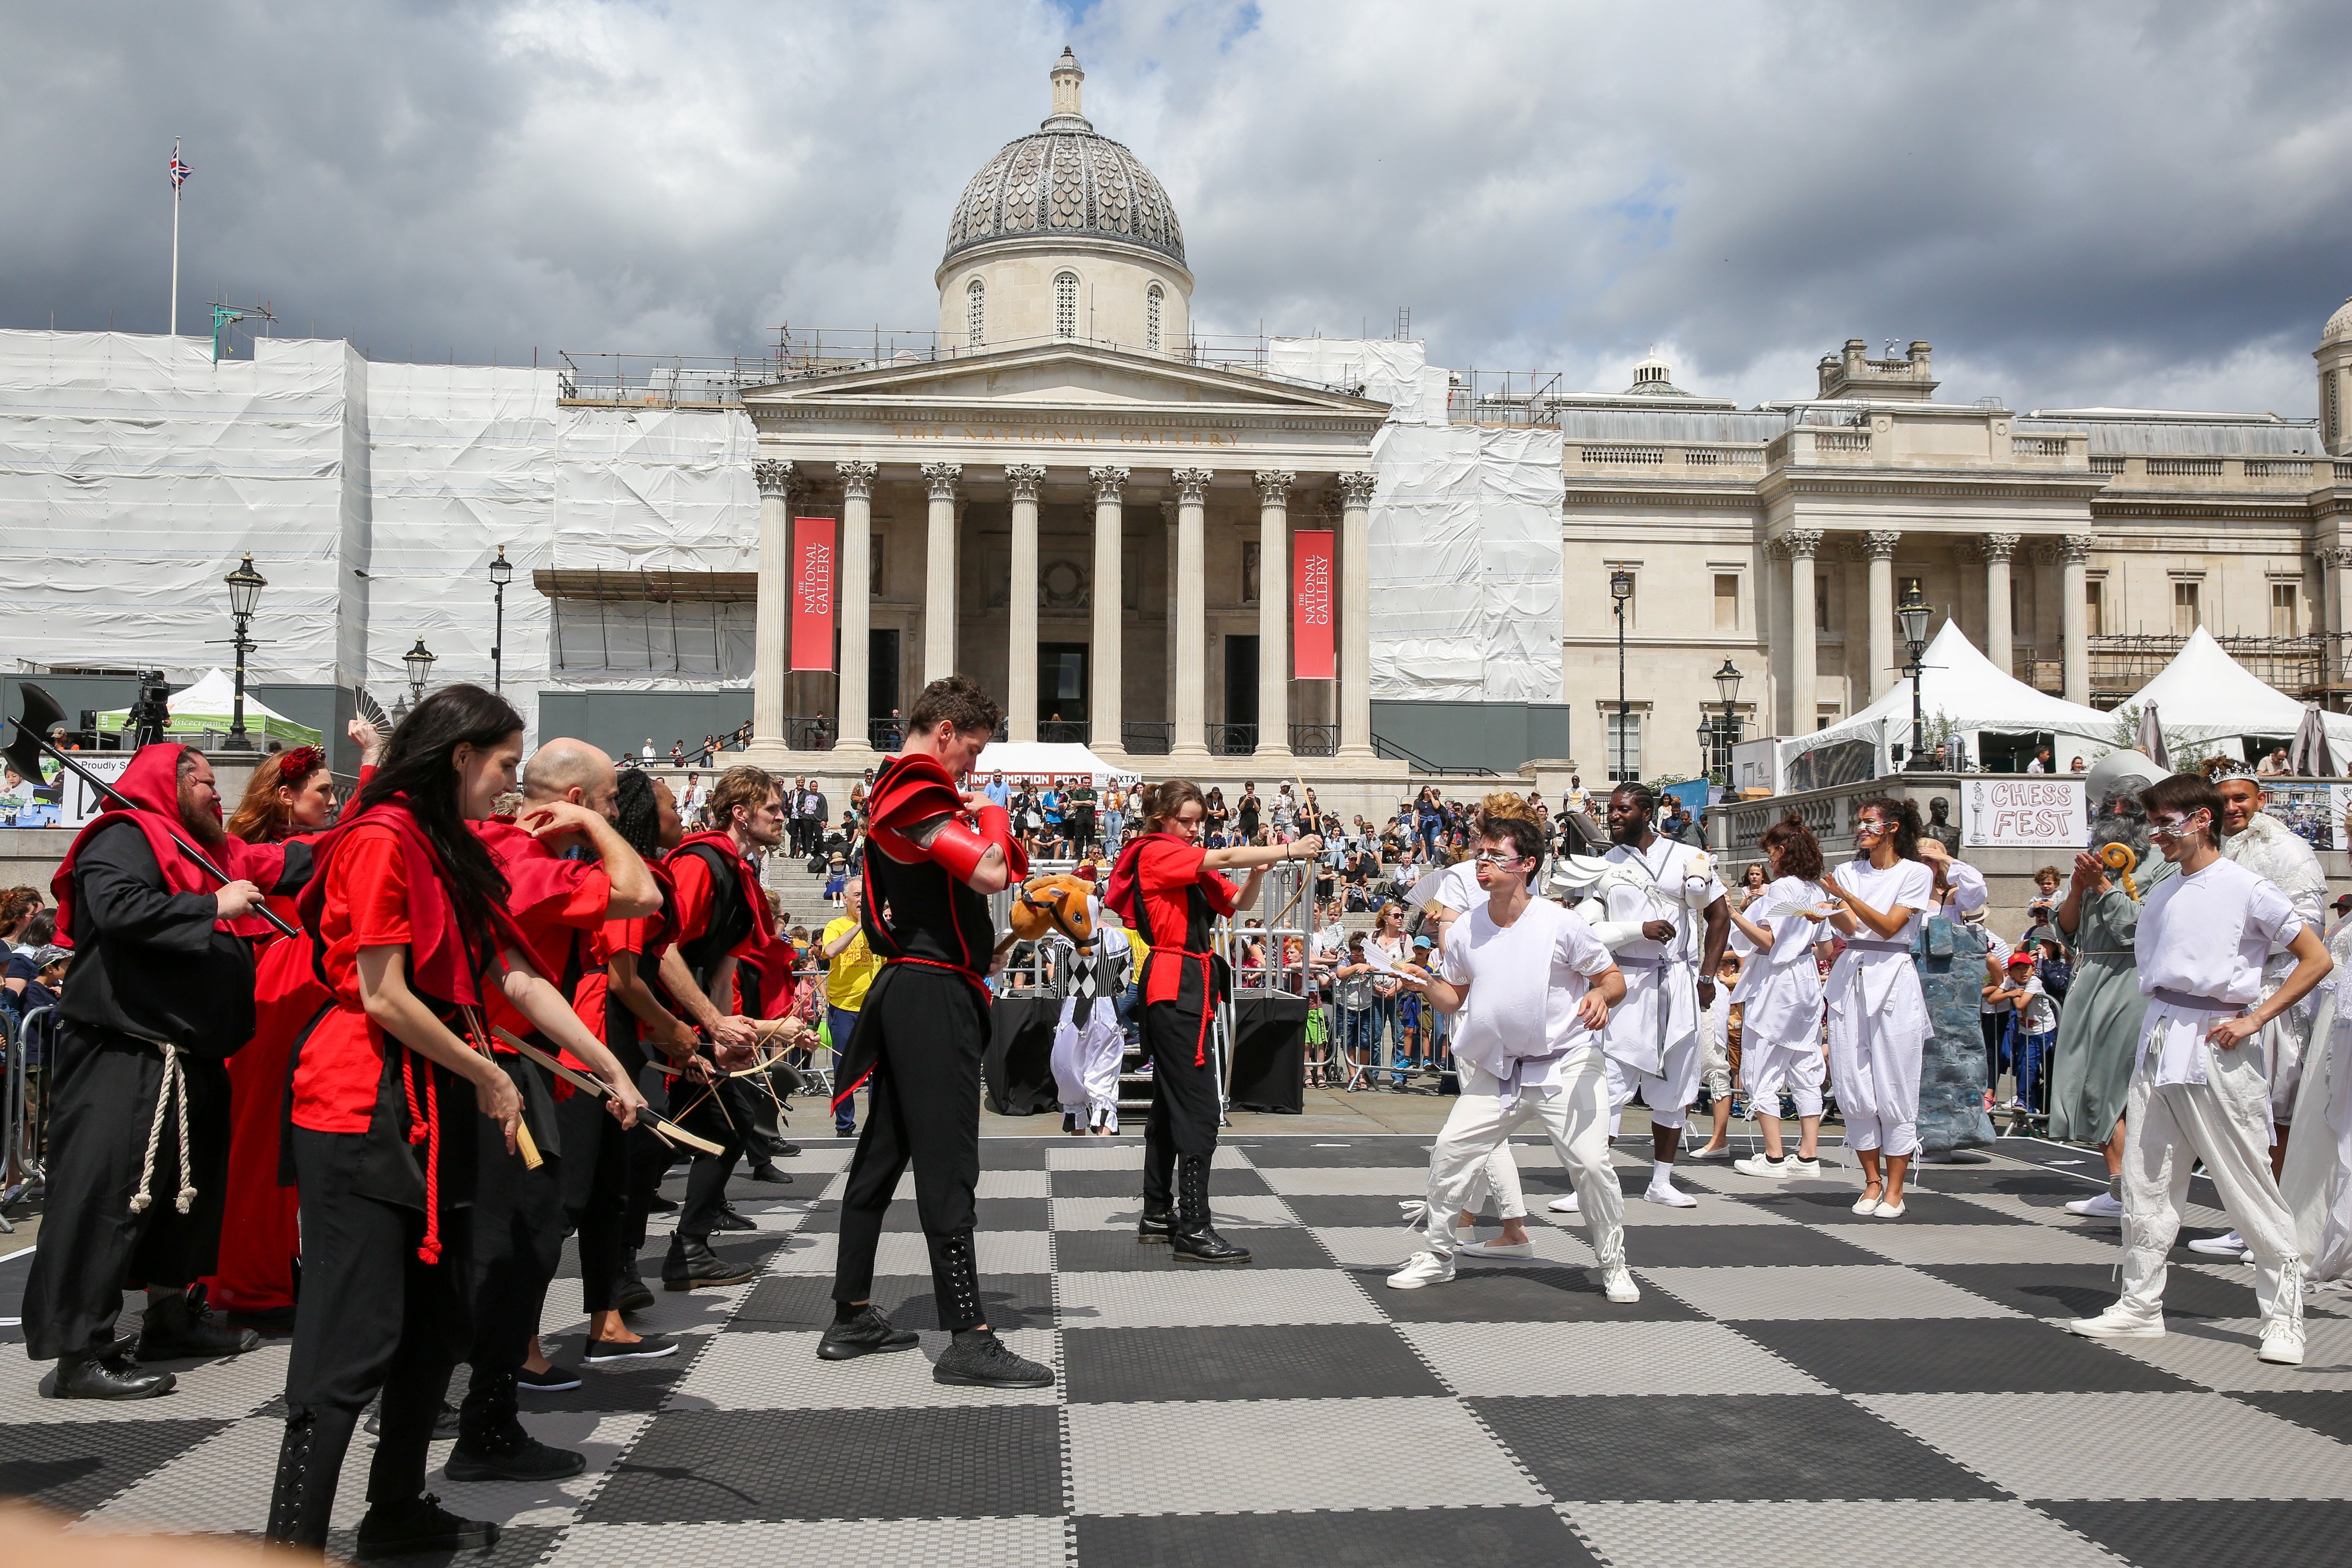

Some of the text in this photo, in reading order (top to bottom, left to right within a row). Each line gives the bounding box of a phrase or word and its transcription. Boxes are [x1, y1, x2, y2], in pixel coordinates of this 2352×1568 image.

[893, 426, 1241, 447] THE NATIONAL GALLERY
[804, 542, 817, 614] NATIONAL
[816, 543, 830, 614] GALLERY
[1305, 554, 1315, 624] NATIONAL
[1317, 555, 1328, 625] GALLERY
[81, 761, 116, 771] Proudly
[1991, 782, 2072, 807] CHESS
[1993, 809, 2073, 837] FEST
